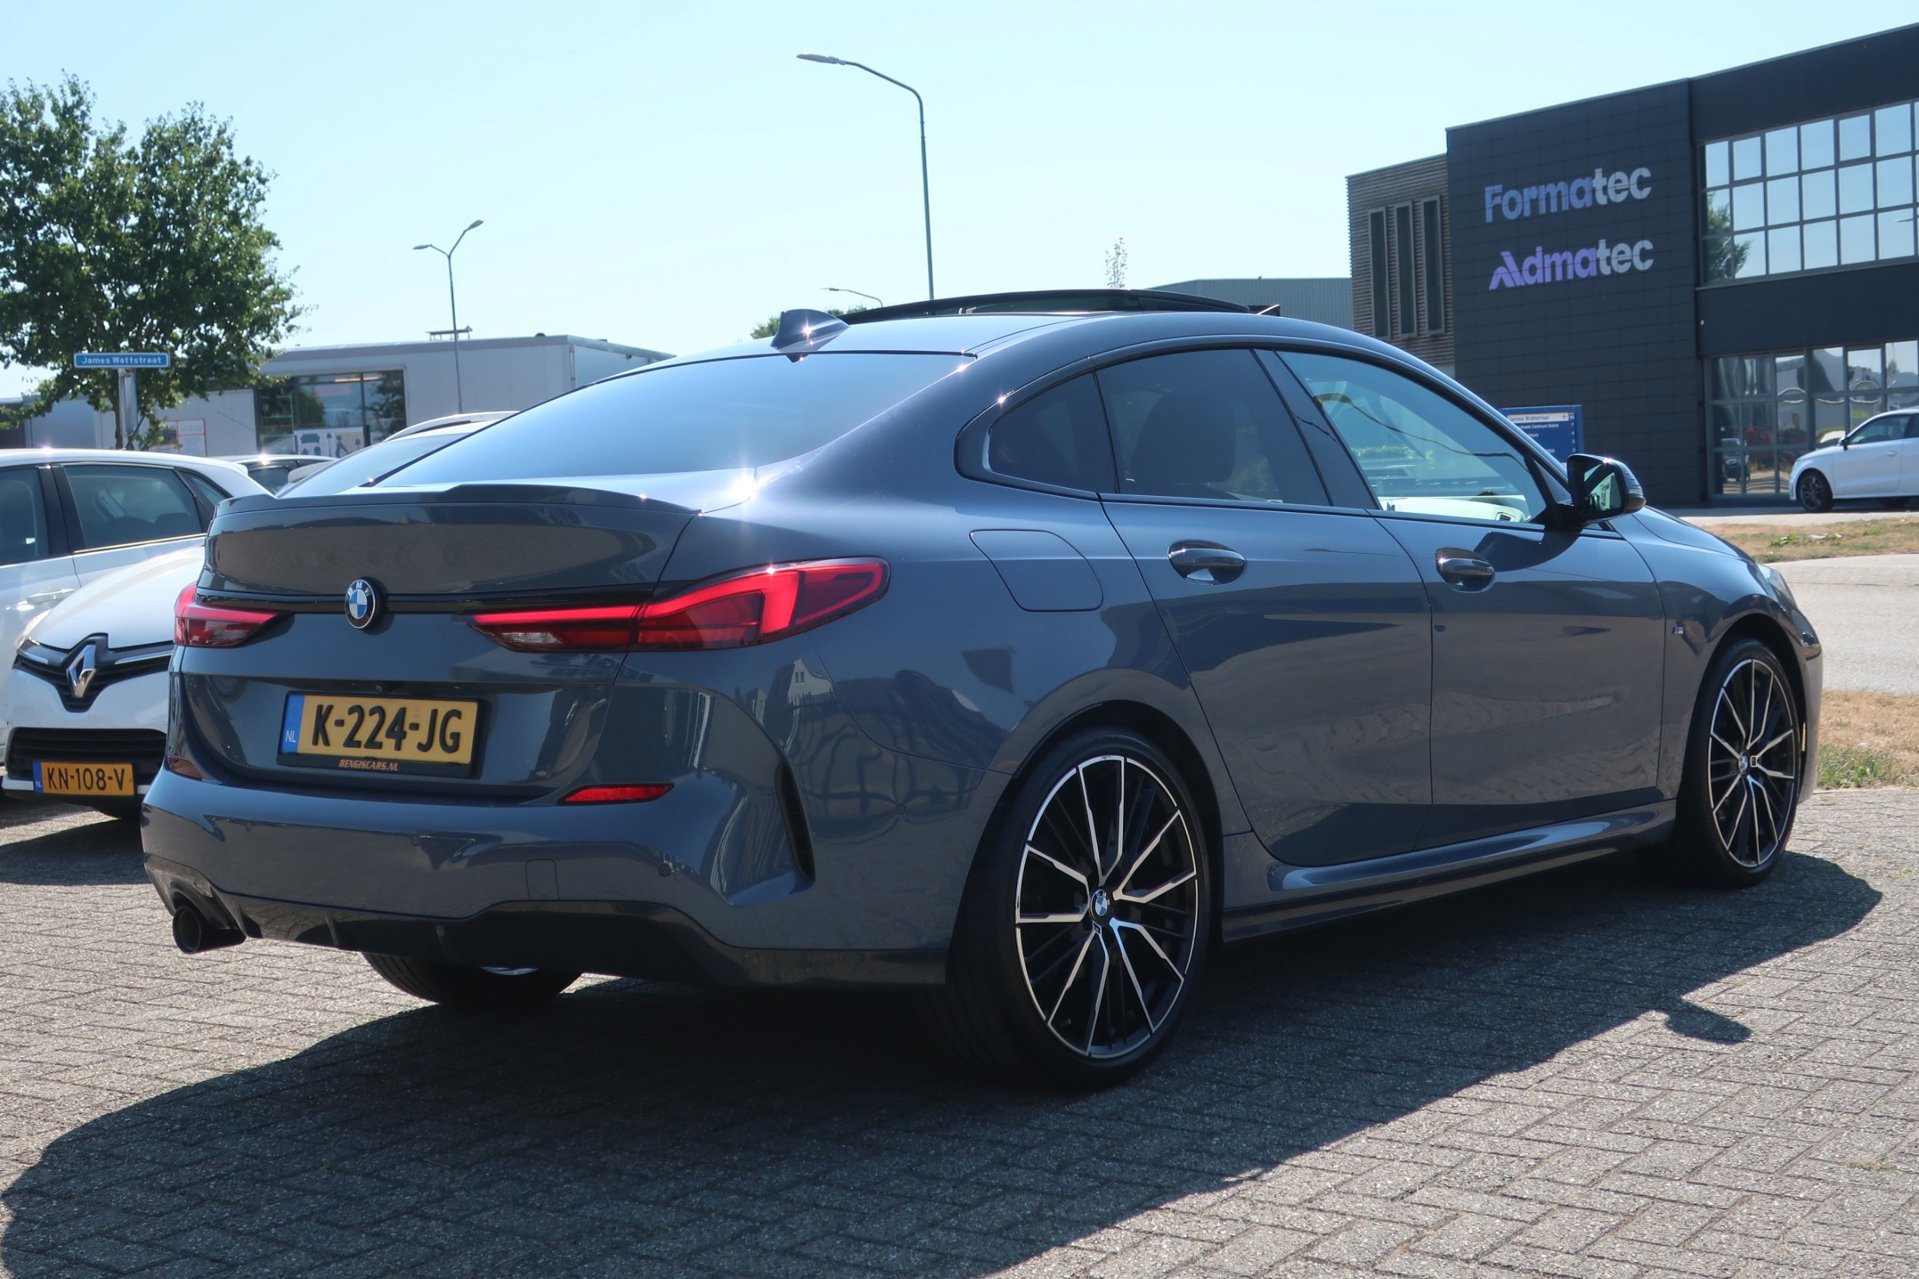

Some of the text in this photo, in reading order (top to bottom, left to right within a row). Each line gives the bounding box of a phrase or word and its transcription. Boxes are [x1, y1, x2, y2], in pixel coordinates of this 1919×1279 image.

[1485, 167, 1652, 223] Formatec
[1489, 239, 1654, 290] Admatec
[112, 356, 162, 364] Wattstraat
[285, 729, 297, 743] NL
[312, 704, 462, 754] K-224-JG
[338, 759, 400, 771] BENGISCARS.NL
[47, 767, 125, 791] KN-108-V
